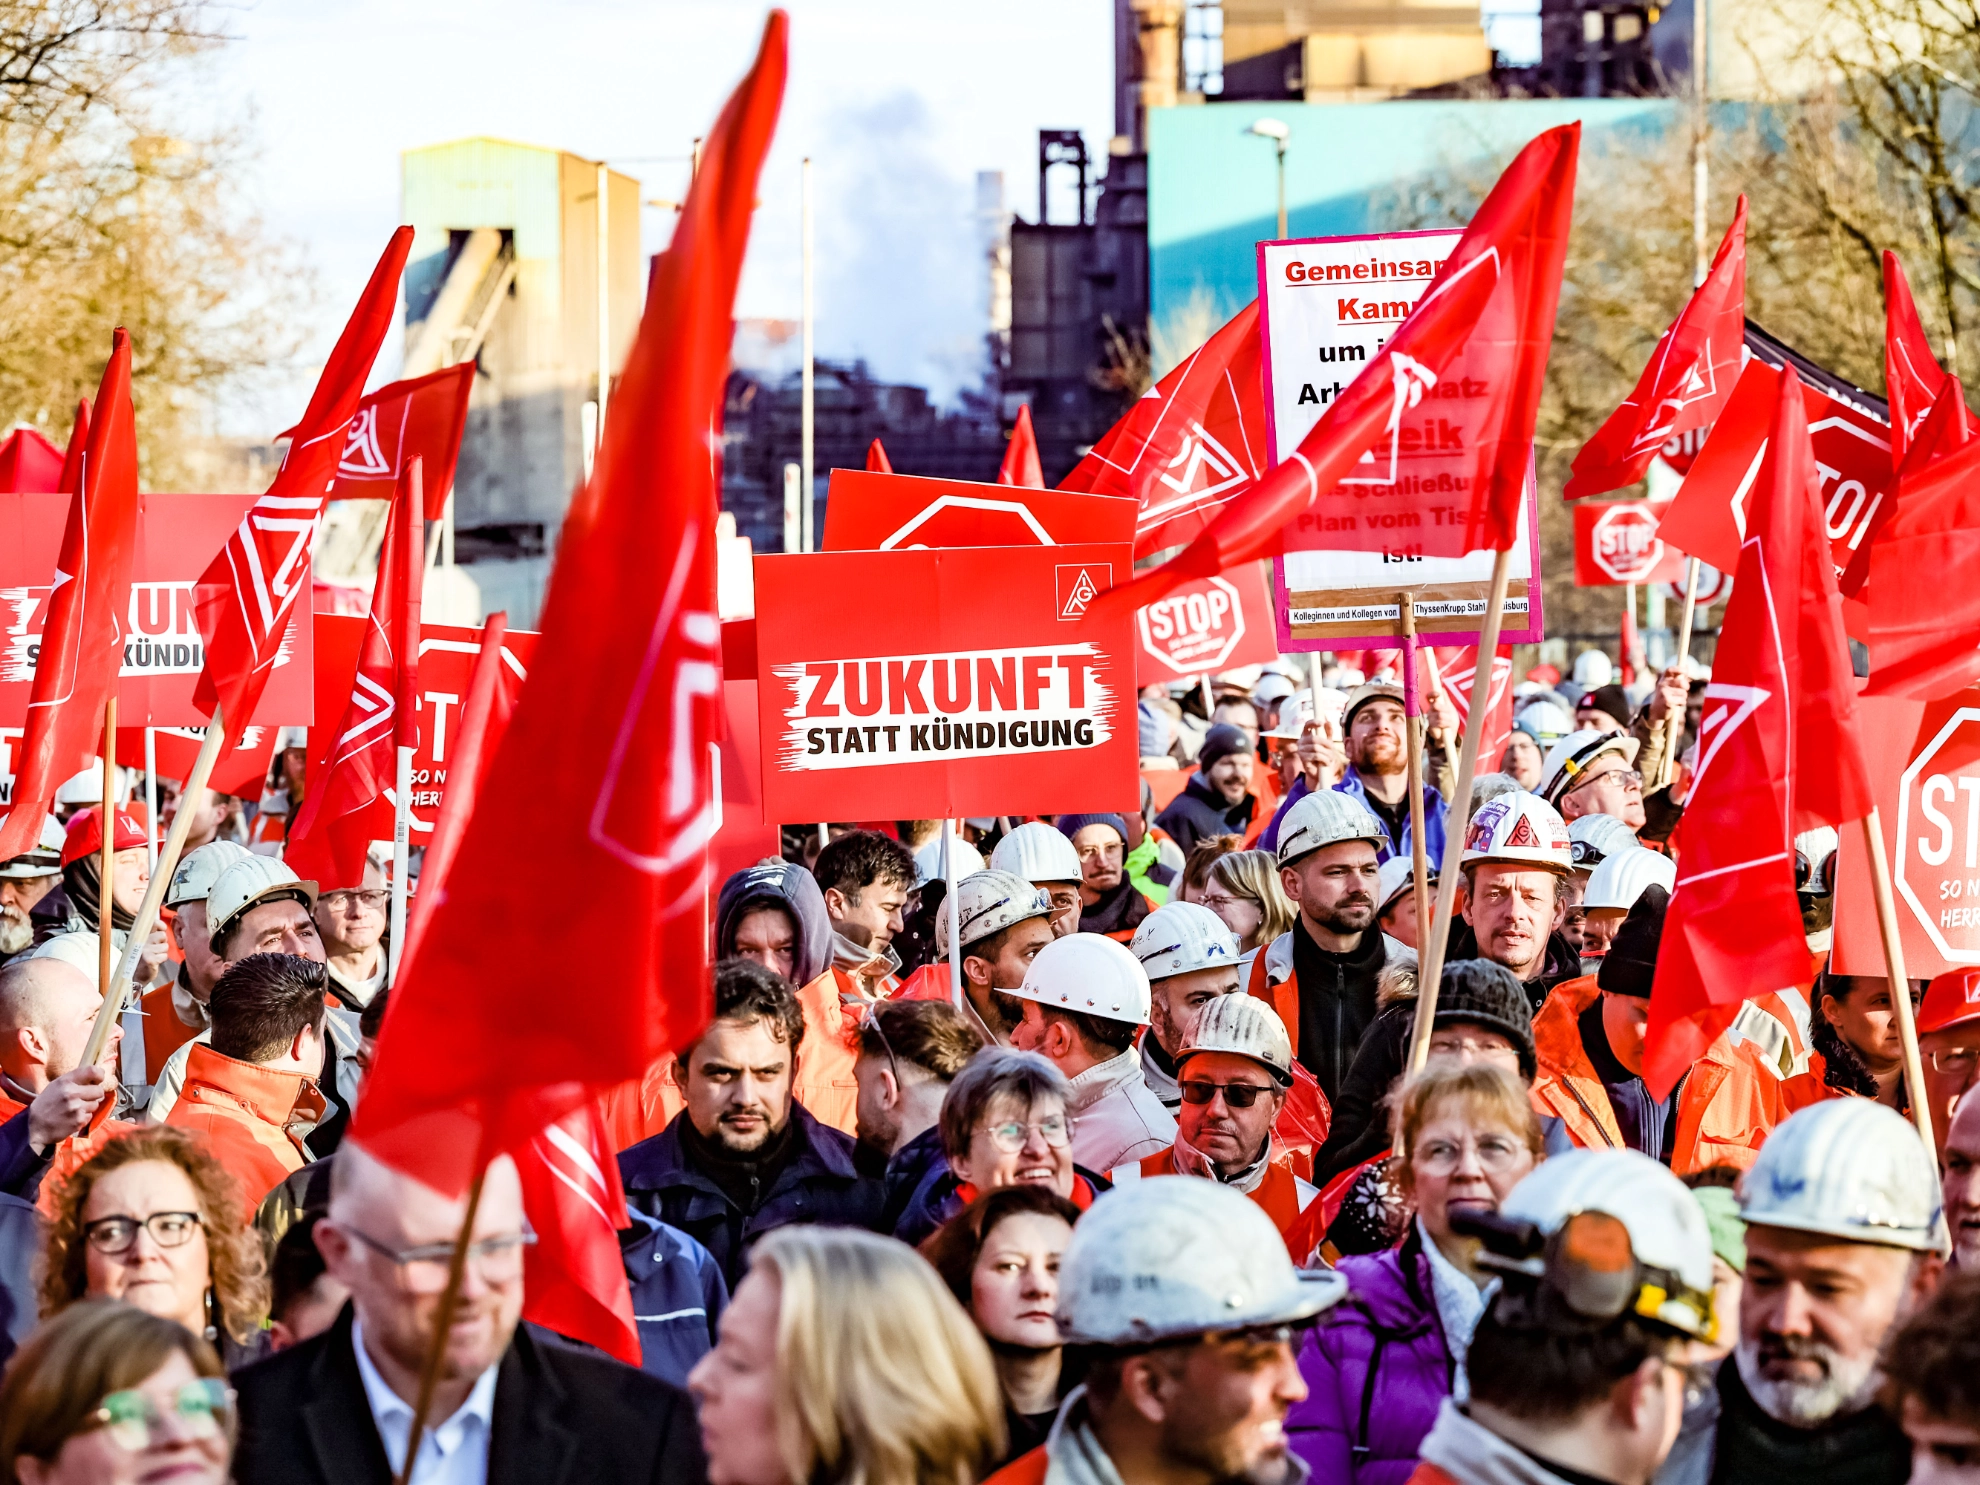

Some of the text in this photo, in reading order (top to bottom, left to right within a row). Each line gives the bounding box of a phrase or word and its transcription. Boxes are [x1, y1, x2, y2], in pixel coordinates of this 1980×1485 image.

[1338, 298, 1418, 321] Kam
[1319, 343, 1365, 362] um
[1297, 513, 1357, 533] Plan
[1366, 511, 1421, 529] vom
[1383, 543, 1423, 563] ist!
[1148, 589, 1230, 640] STOP
[1293, 608, 1397, 622] Kolleginnen und Kollegen von
[1415, 601, 1528, 615] ThyssenKrupp Stahl isburg
[805, 655, 1094, 718] ZUKUNFT
[807, 717, 1094, 755] STATT KÜNDIGUNG
[1939, 879, 1962, 900] SO
